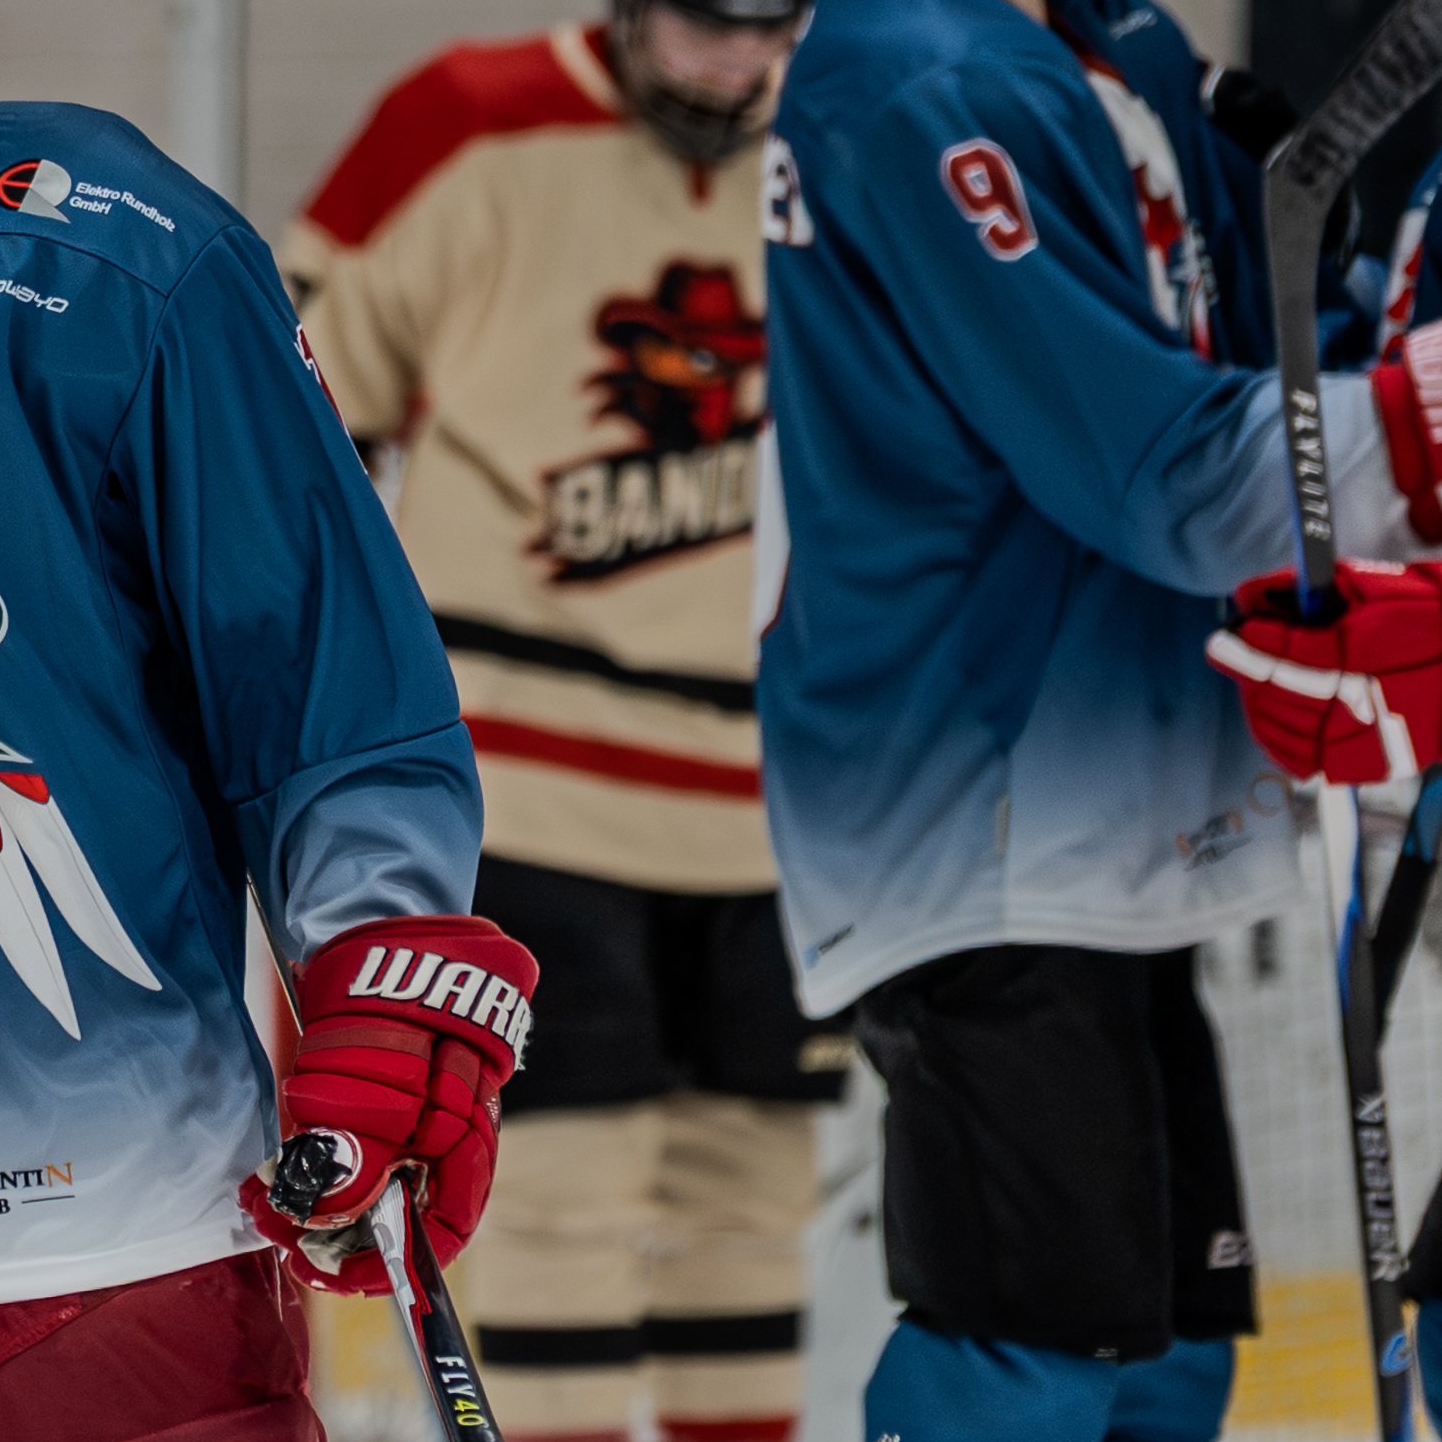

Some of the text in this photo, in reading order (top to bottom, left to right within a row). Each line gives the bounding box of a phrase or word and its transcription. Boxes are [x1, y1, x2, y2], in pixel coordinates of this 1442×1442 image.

[69, 195, 113, 216] GmbH
[74, 181, 177, 233] Elektro Rundholz
[940, 138, 1039, 262] 9
